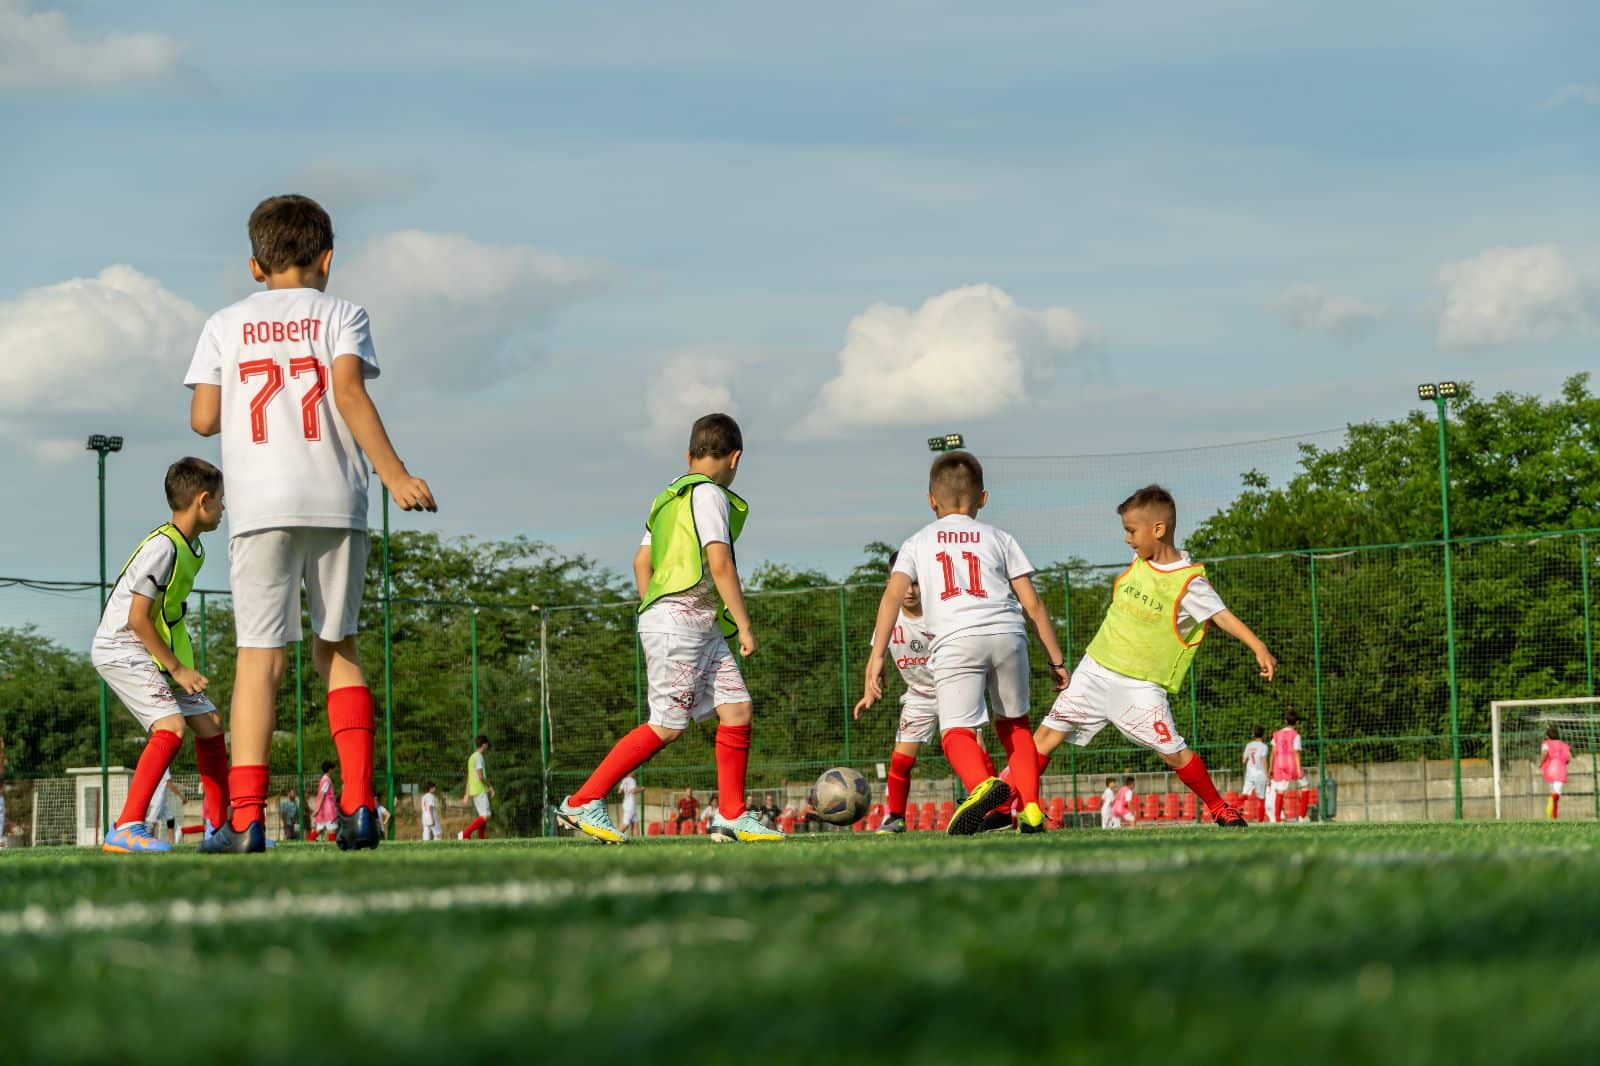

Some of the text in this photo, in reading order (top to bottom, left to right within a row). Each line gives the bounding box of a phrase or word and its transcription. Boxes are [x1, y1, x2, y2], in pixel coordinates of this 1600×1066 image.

[243, 318, 322, 345] ROBERT
[239, 355, 328, 444] 77
[937, 531, 981, 543] ANDU
[935, 550, 988, 601] 11
[1153, 720, 1172, 743] 9
